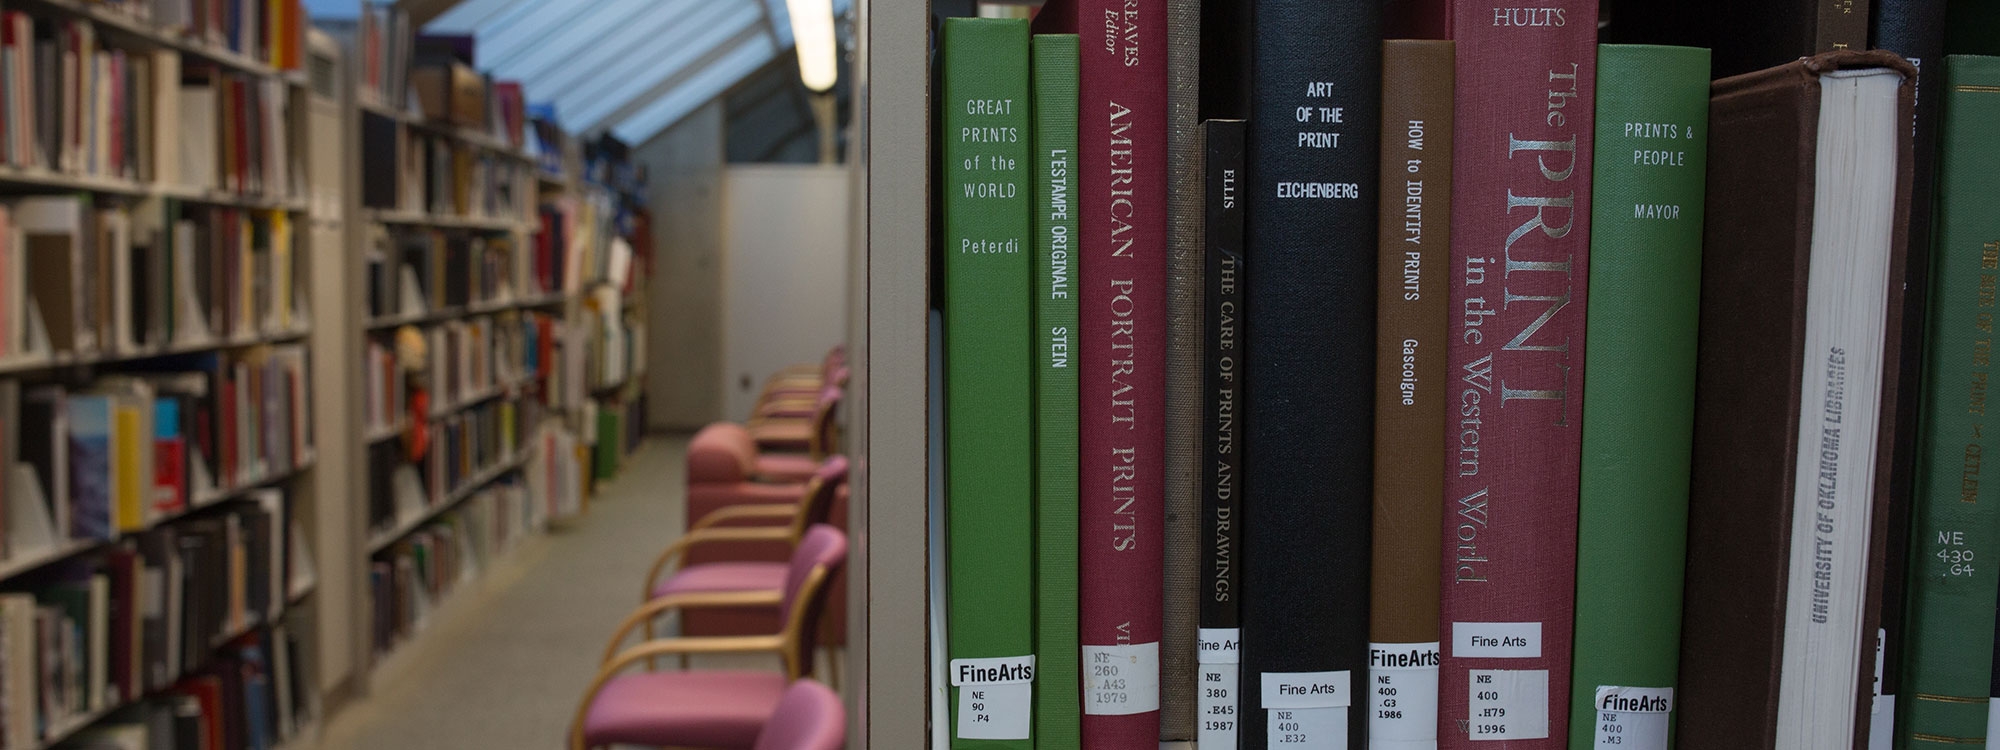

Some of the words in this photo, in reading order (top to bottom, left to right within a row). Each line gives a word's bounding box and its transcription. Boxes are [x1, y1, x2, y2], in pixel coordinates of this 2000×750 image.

[1493, 8, 1566, 27] HULTS
[1105, 9, 1119, 54] Editor
[1124, 0, 1139, 67] REAVES
[1307, 82, 1334, 98] ART
[1547, 62, 1578, 127] The
[967, 100, 1012, 115] GREAT
[1296, 107, 1312, 123] OF
[1319, 107, 1343, 123] THE
[962, 127, 1017, 143] PRINTS
[1408, 120, 1423, 150] HOW
[1625, 123, 1678, 140] PRINTS
[1686, 127, 1693, 139] &
[1299, 133, 1339, 148] PRINT
[964, 155, 979, 170] of
[992, 155, 1015, 170] the
[1407, 159, 1422, 173] to
[1634, 150, 1684, 167] PEOPLE
[1051, 150, 1067, 221] L'ESTAMPE
[1109, 101, 1134, 258] AMERICAN
[964, 184, 1016, 198] WORLD
[1224, 169, 1234, 209] ELLIS
[1277, 182, 1358, 199] EICHENBERG
[1406, 180, 1422, 244] IDENTIFY
[1634, 204, 1680, 220] MAYOR
[962, 238, 1018, 254] Peterdi
[1051, 227, 1067, 300] ORIGINALE
[1466, 256, 1495, 286] in
[1221, 256, 1235, 295] THE
[1404, 251, 1420, 301] PRINTS
[1501, 132, 1577, 427] PRINT
[1220, 301, 1235, 350] CARE
[1464, 297, 1496, 345] the
[1052, 327, 1067, 368] STEIN
[1110, 279, 1135, 430] PORTRAIT
[1219, 356, 1233, 382] OF
[1400, 339, 1418, 405] Gascoigne
[1826, 346, 1846, 424] LIBRARIES
[1218, 389, 1233, 454] PRINTS
[1460, 352, 1493, 478] Western
[1818, 427, 1841, 511] OKLAHOMA
[1217, 461, 1232, 500] AND
[1112, 447, 1136, 551] PRINTS
[1817, 512, 1834, 536] OF
[1456, 486, 1489, 584] World
[1938, 531, 1963, 545] NE
[1215, 507, 1231, 602] DRAWINGS
[1937, 550, 1974, 564] 430
[1812, 538, 1833, 625] UNIVERSITY
[1198, 639, 1219, 650] ine
[1472, 636, 1499, 647] Fine
[1502, 636, 1527, 647] Arts
[1094, 653, 1110, 664] NE
[1371, 649, 1440, 667] FineArts
[960, 663, 1032, 683] FineArts
[1094, 666, 1118, 676] 260
[1206, 673, 1221, 682] NE
[1096, 679, 1126, 690] .A43
[1378, 676, 1390, 684] NE
[1477, 675, 1492, 684] NE
[972, 691, 984, 700] NE
[1206, 688, 1227, 698] 380
[1280, 684, 1306, 695] Fine
[1310, 683, 1335, 694] Arts
[1378, 687, 1397, 696] 400
[1477, 691, 1498, 700] 400
[1096, 693, 1127, 703] 1979
[1379, 699, 1396, 708] .G3
[1603, 694, 1667, 711] FineArts
[972, 703, 984, 711] 90
[1207, 705, 1234, 715] .E45
[1378, 711, 1402, 719] 1986
[1478, 708, 1505, 718] .H79
[972, 714, 990, 723] .P4
[1278, 712, 1292, 720] NE
[1602, 714, 1617, 722] NE
[1205, 721, 1233, 731] 1987
[1278, 722, 1299, 731] 400
[1477, 725, 1506, 734] 1996
[1602, 724, 1622, 733] 400
[1279, 734, 1306, 743] .E32
[1603, 736, 1622, 745] .M3
